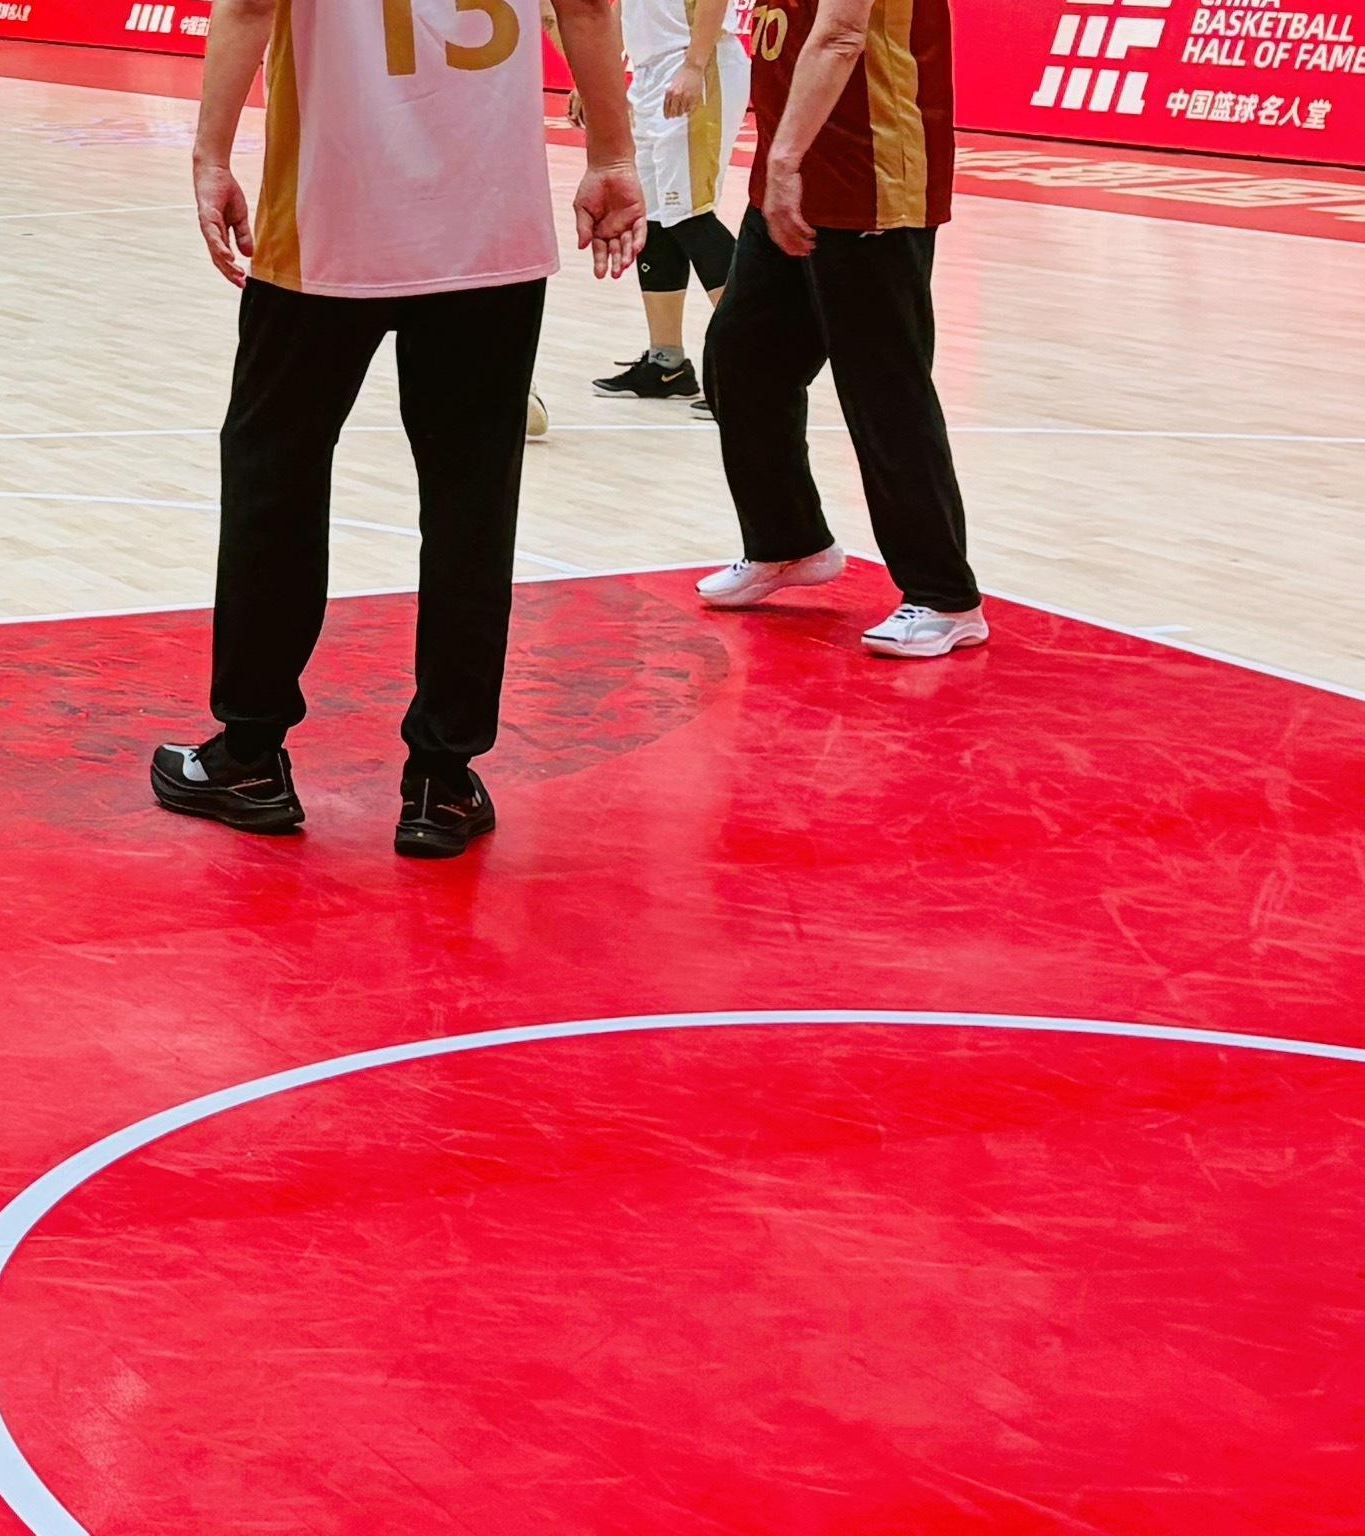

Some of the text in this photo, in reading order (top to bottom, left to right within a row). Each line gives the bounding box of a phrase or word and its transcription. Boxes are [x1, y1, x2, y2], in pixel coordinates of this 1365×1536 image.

[1190, 9, 1354, 43] BASKETBALL
[1182, 42, 1365, 74] HALL OF FAME
[1166, 89, 1332, 131] 中国篮球名人堂
